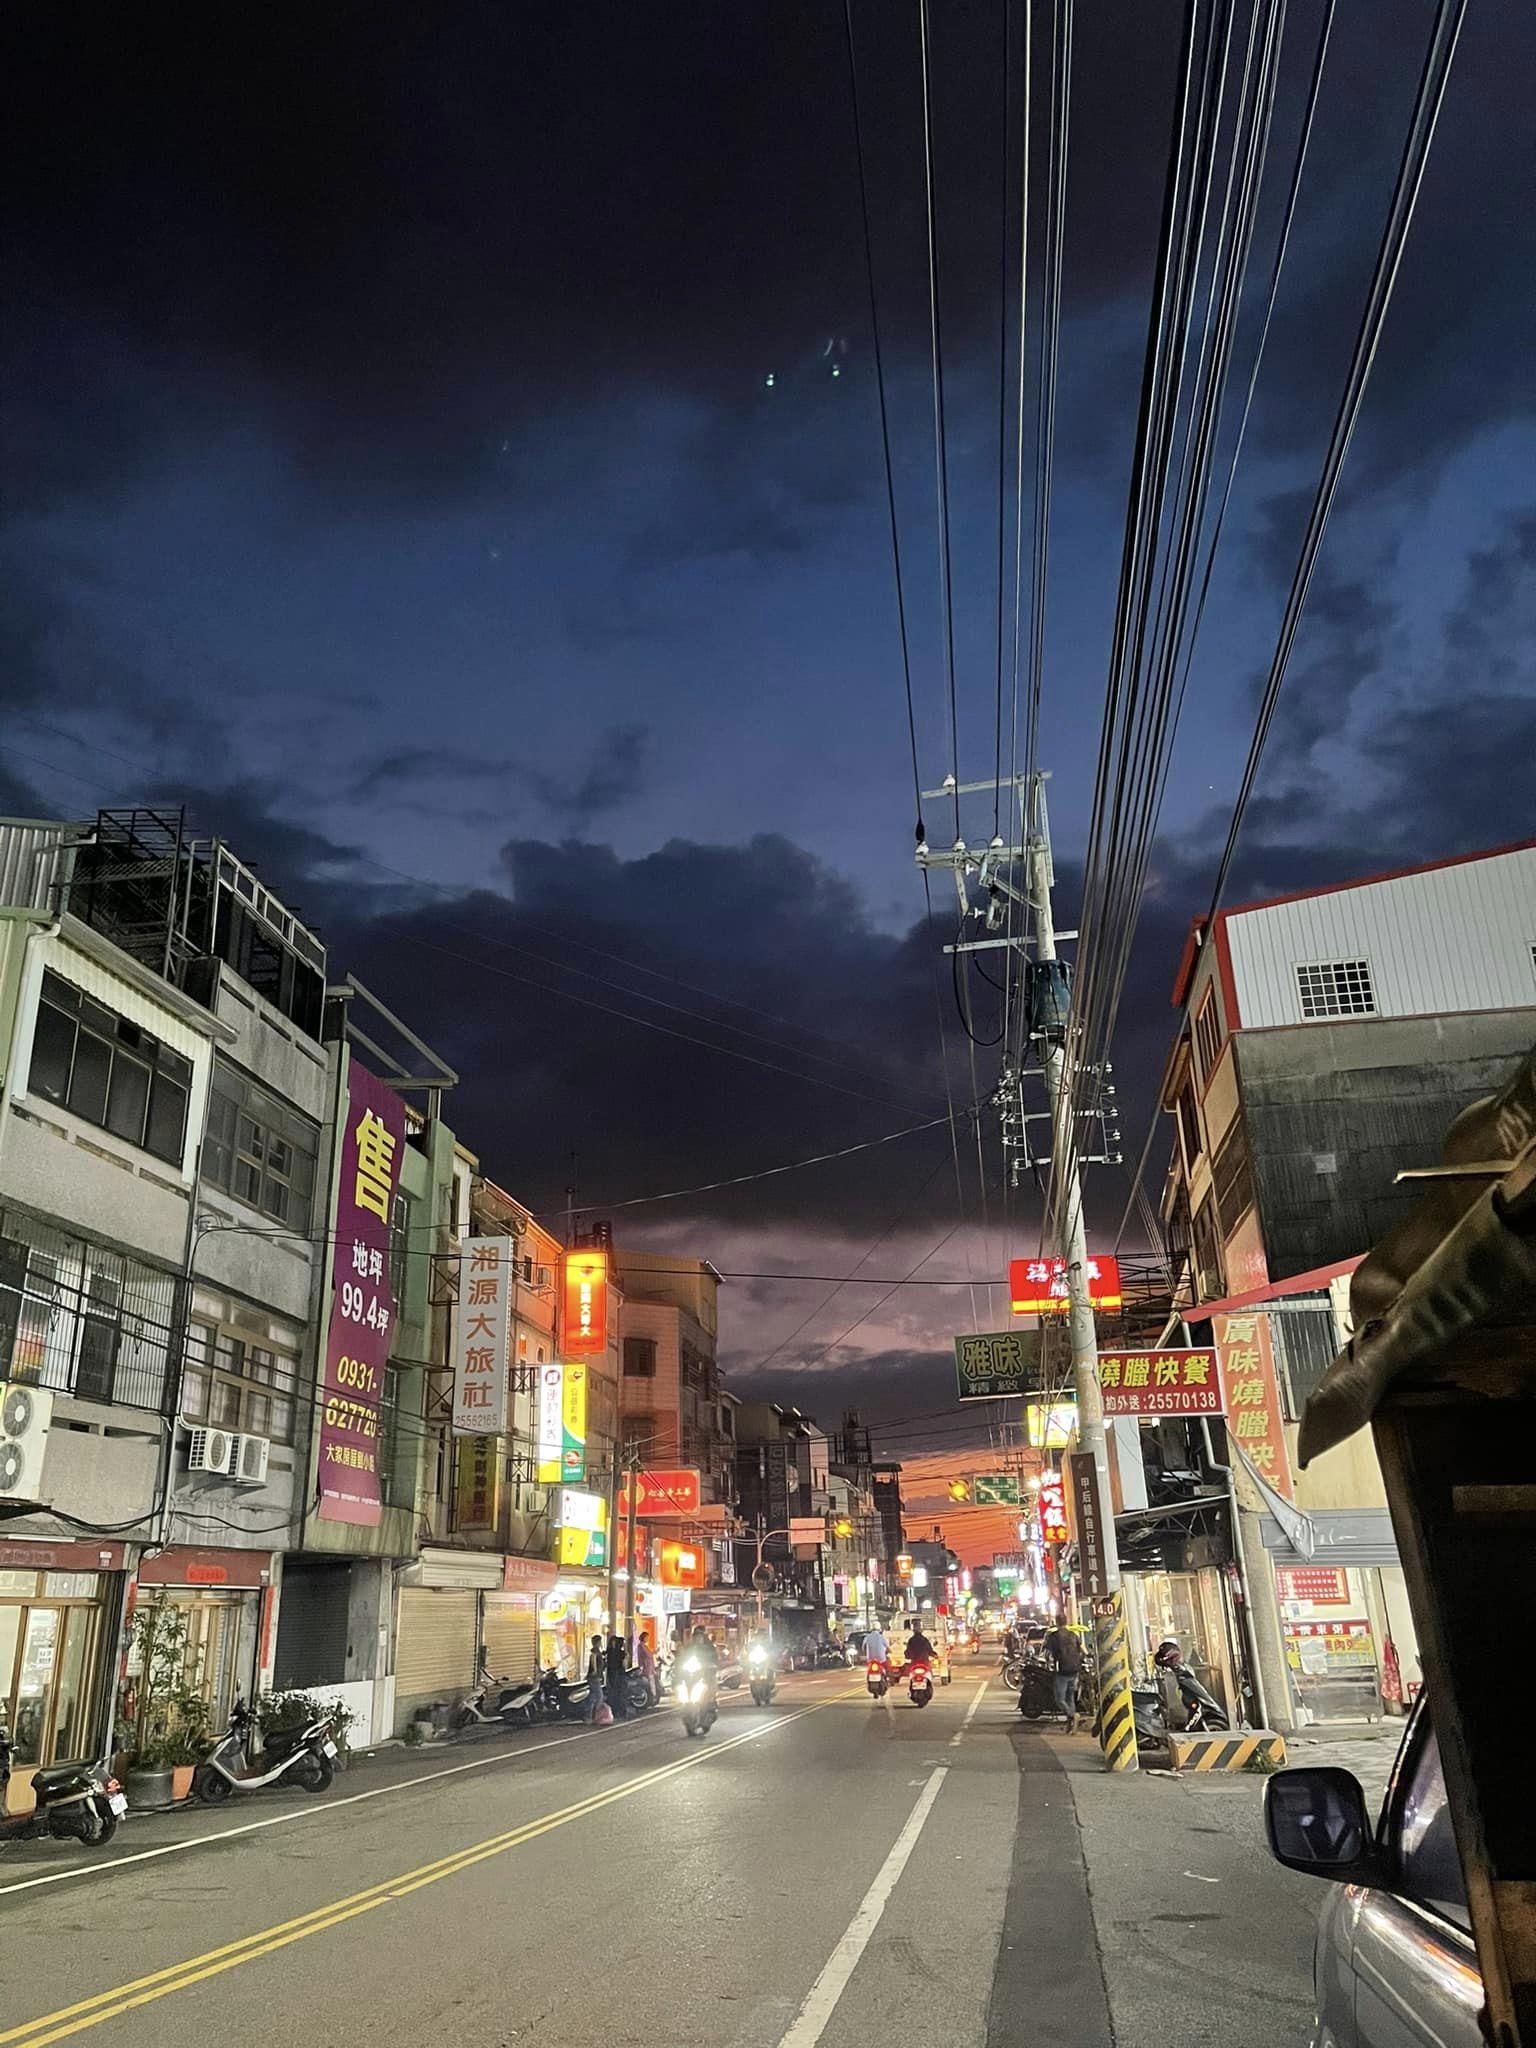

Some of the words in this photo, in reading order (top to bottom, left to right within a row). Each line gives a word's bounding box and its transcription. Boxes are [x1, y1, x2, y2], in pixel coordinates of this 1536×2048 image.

[355, 1107, 396, 1225] 售
[352, 1238, 383, 1286] 地坪
[463, 1245, 499, 1409] 湘源大旅社
